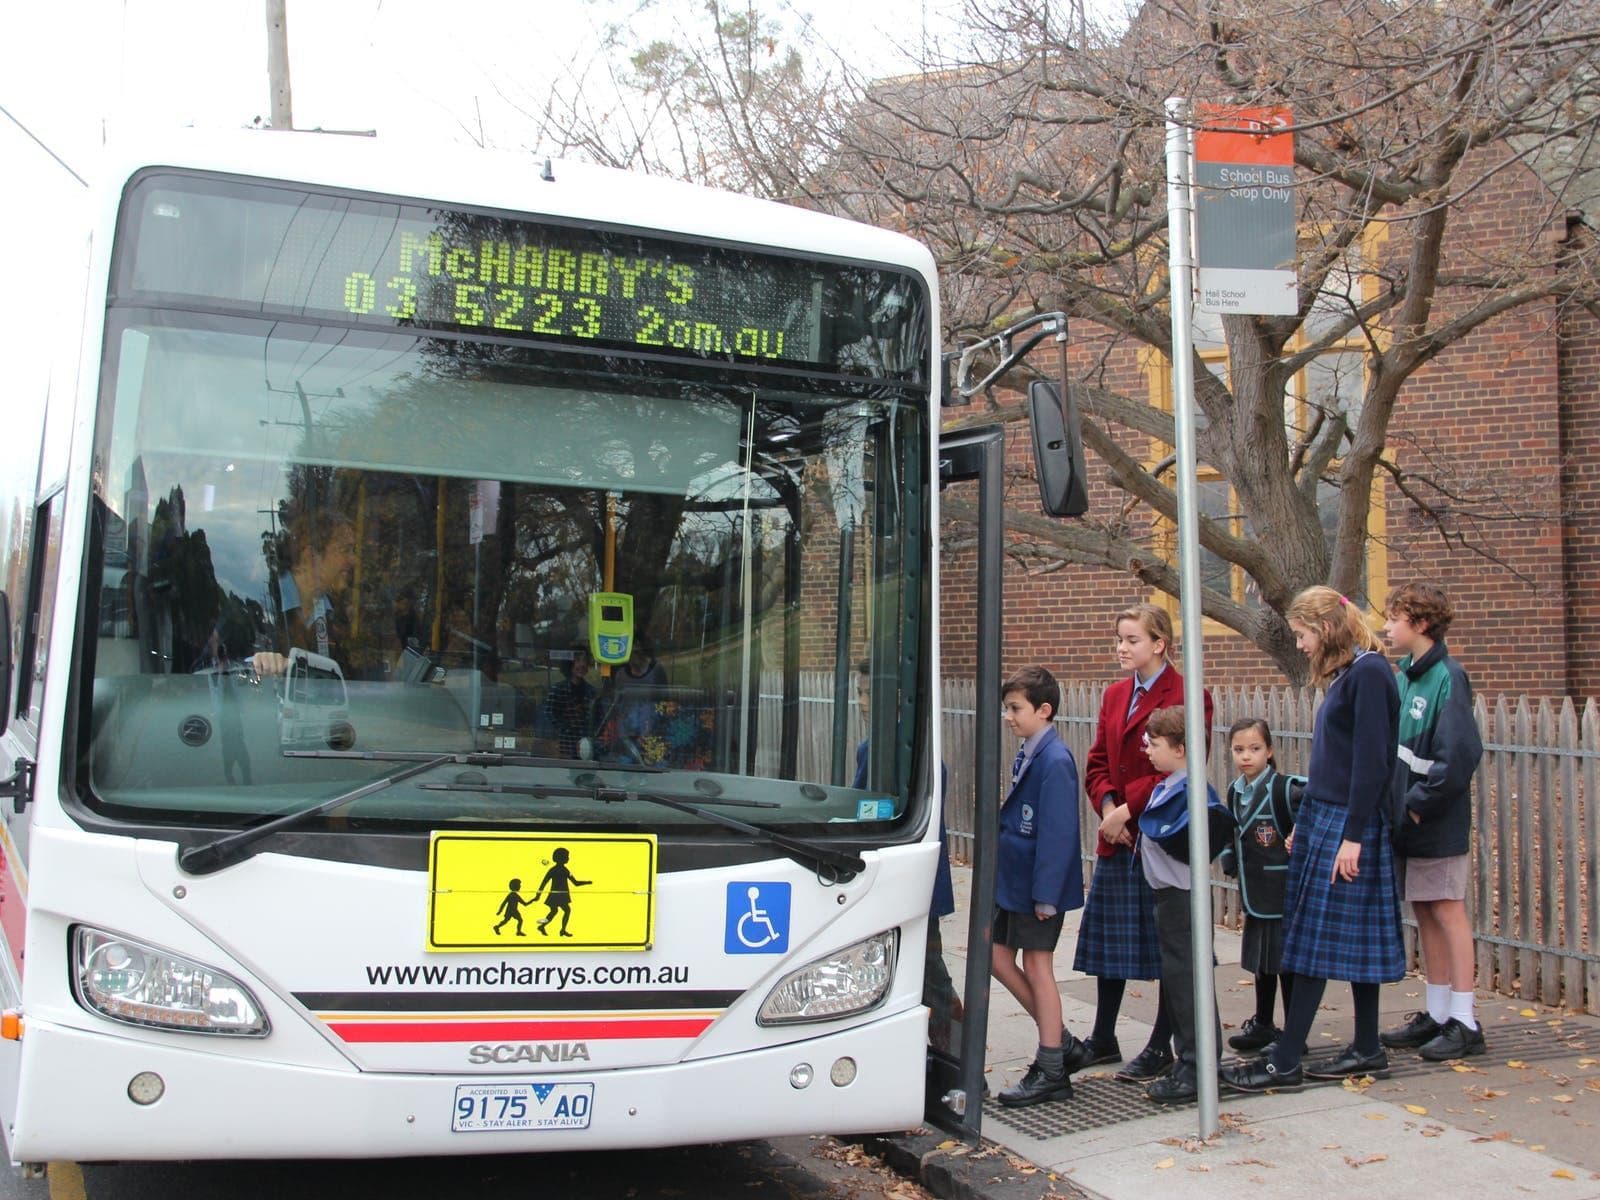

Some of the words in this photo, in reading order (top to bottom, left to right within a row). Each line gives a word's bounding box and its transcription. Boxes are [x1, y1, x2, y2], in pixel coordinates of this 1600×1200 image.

[1220, 168, 1263, 184] School
[1266, 170, 1290, 185] Bus
[1230, 186, 1259, 201] Stop
[1262, 186, 1291, 204] Only
[1205, 298, 1220, 306] Bus
[1221, 298, 1240, 307] Here
[1221, 289, 1246, 299] School
[343, 271, 417, 319] 03
[454, 283, 602, 339] 5223
[365, 961, 690, 991] www.mcharrys.com.au
[468, 1042, 591, 1065] SCANIA
[469, 1088, 509, 1096] ACCREDITED
[457, 1095, 529, 1120] 9175
[553, 1094, 589, 1119] AO
[458, 1120, 473, 1128] VIC
[483, 1119, 505, 1128] STAY
[506, 1119, 532, 1127] ALERT
[559, 1117, 585, 1126] ALIVE
